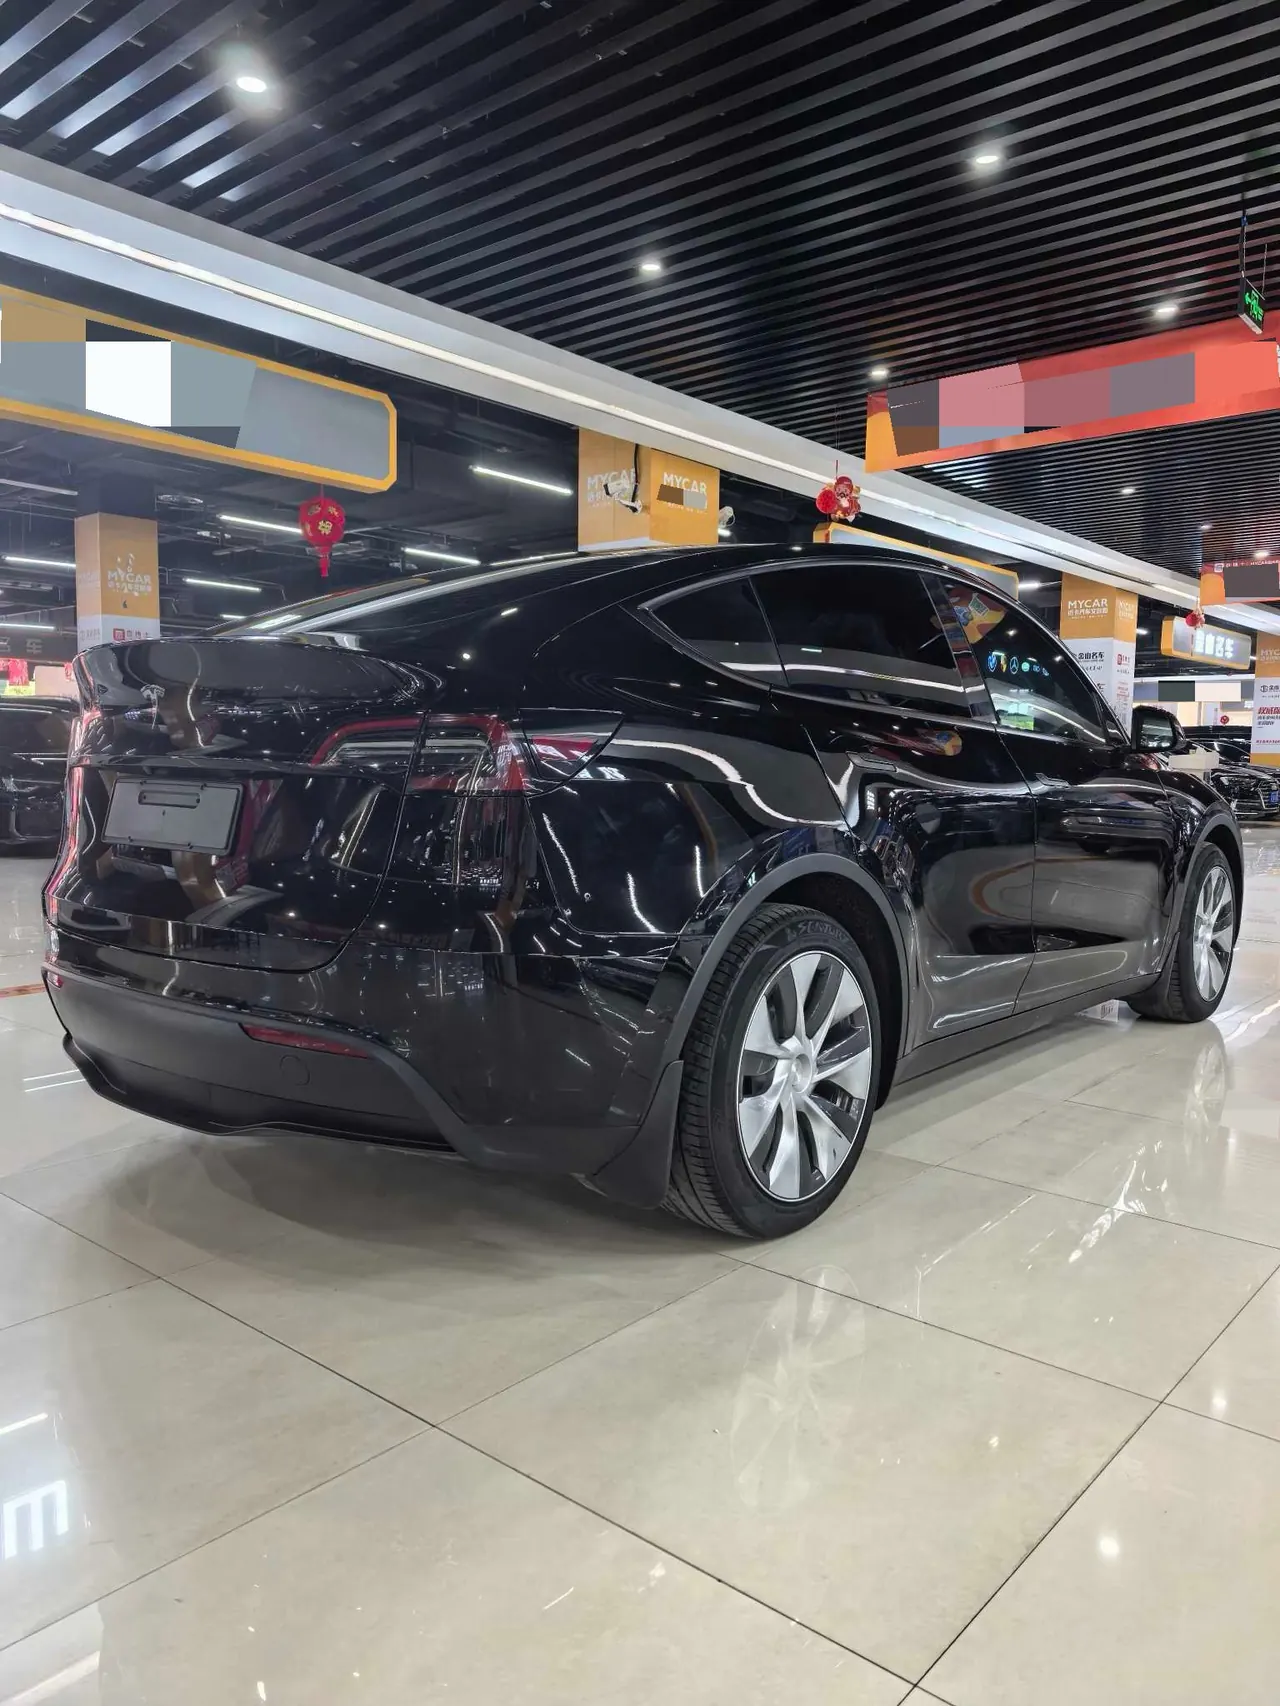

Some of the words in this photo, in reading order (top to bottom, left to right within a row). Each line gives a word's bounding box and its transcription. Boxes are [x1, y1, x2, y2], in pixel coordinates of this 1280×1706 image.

[663, 472, 707, 495] MYCAR
[107, 570, 151, 585] MYCAR
[1068, 598, 1108, 609] MYCAR
[1078, 651, 1105, 660] 金山名车
